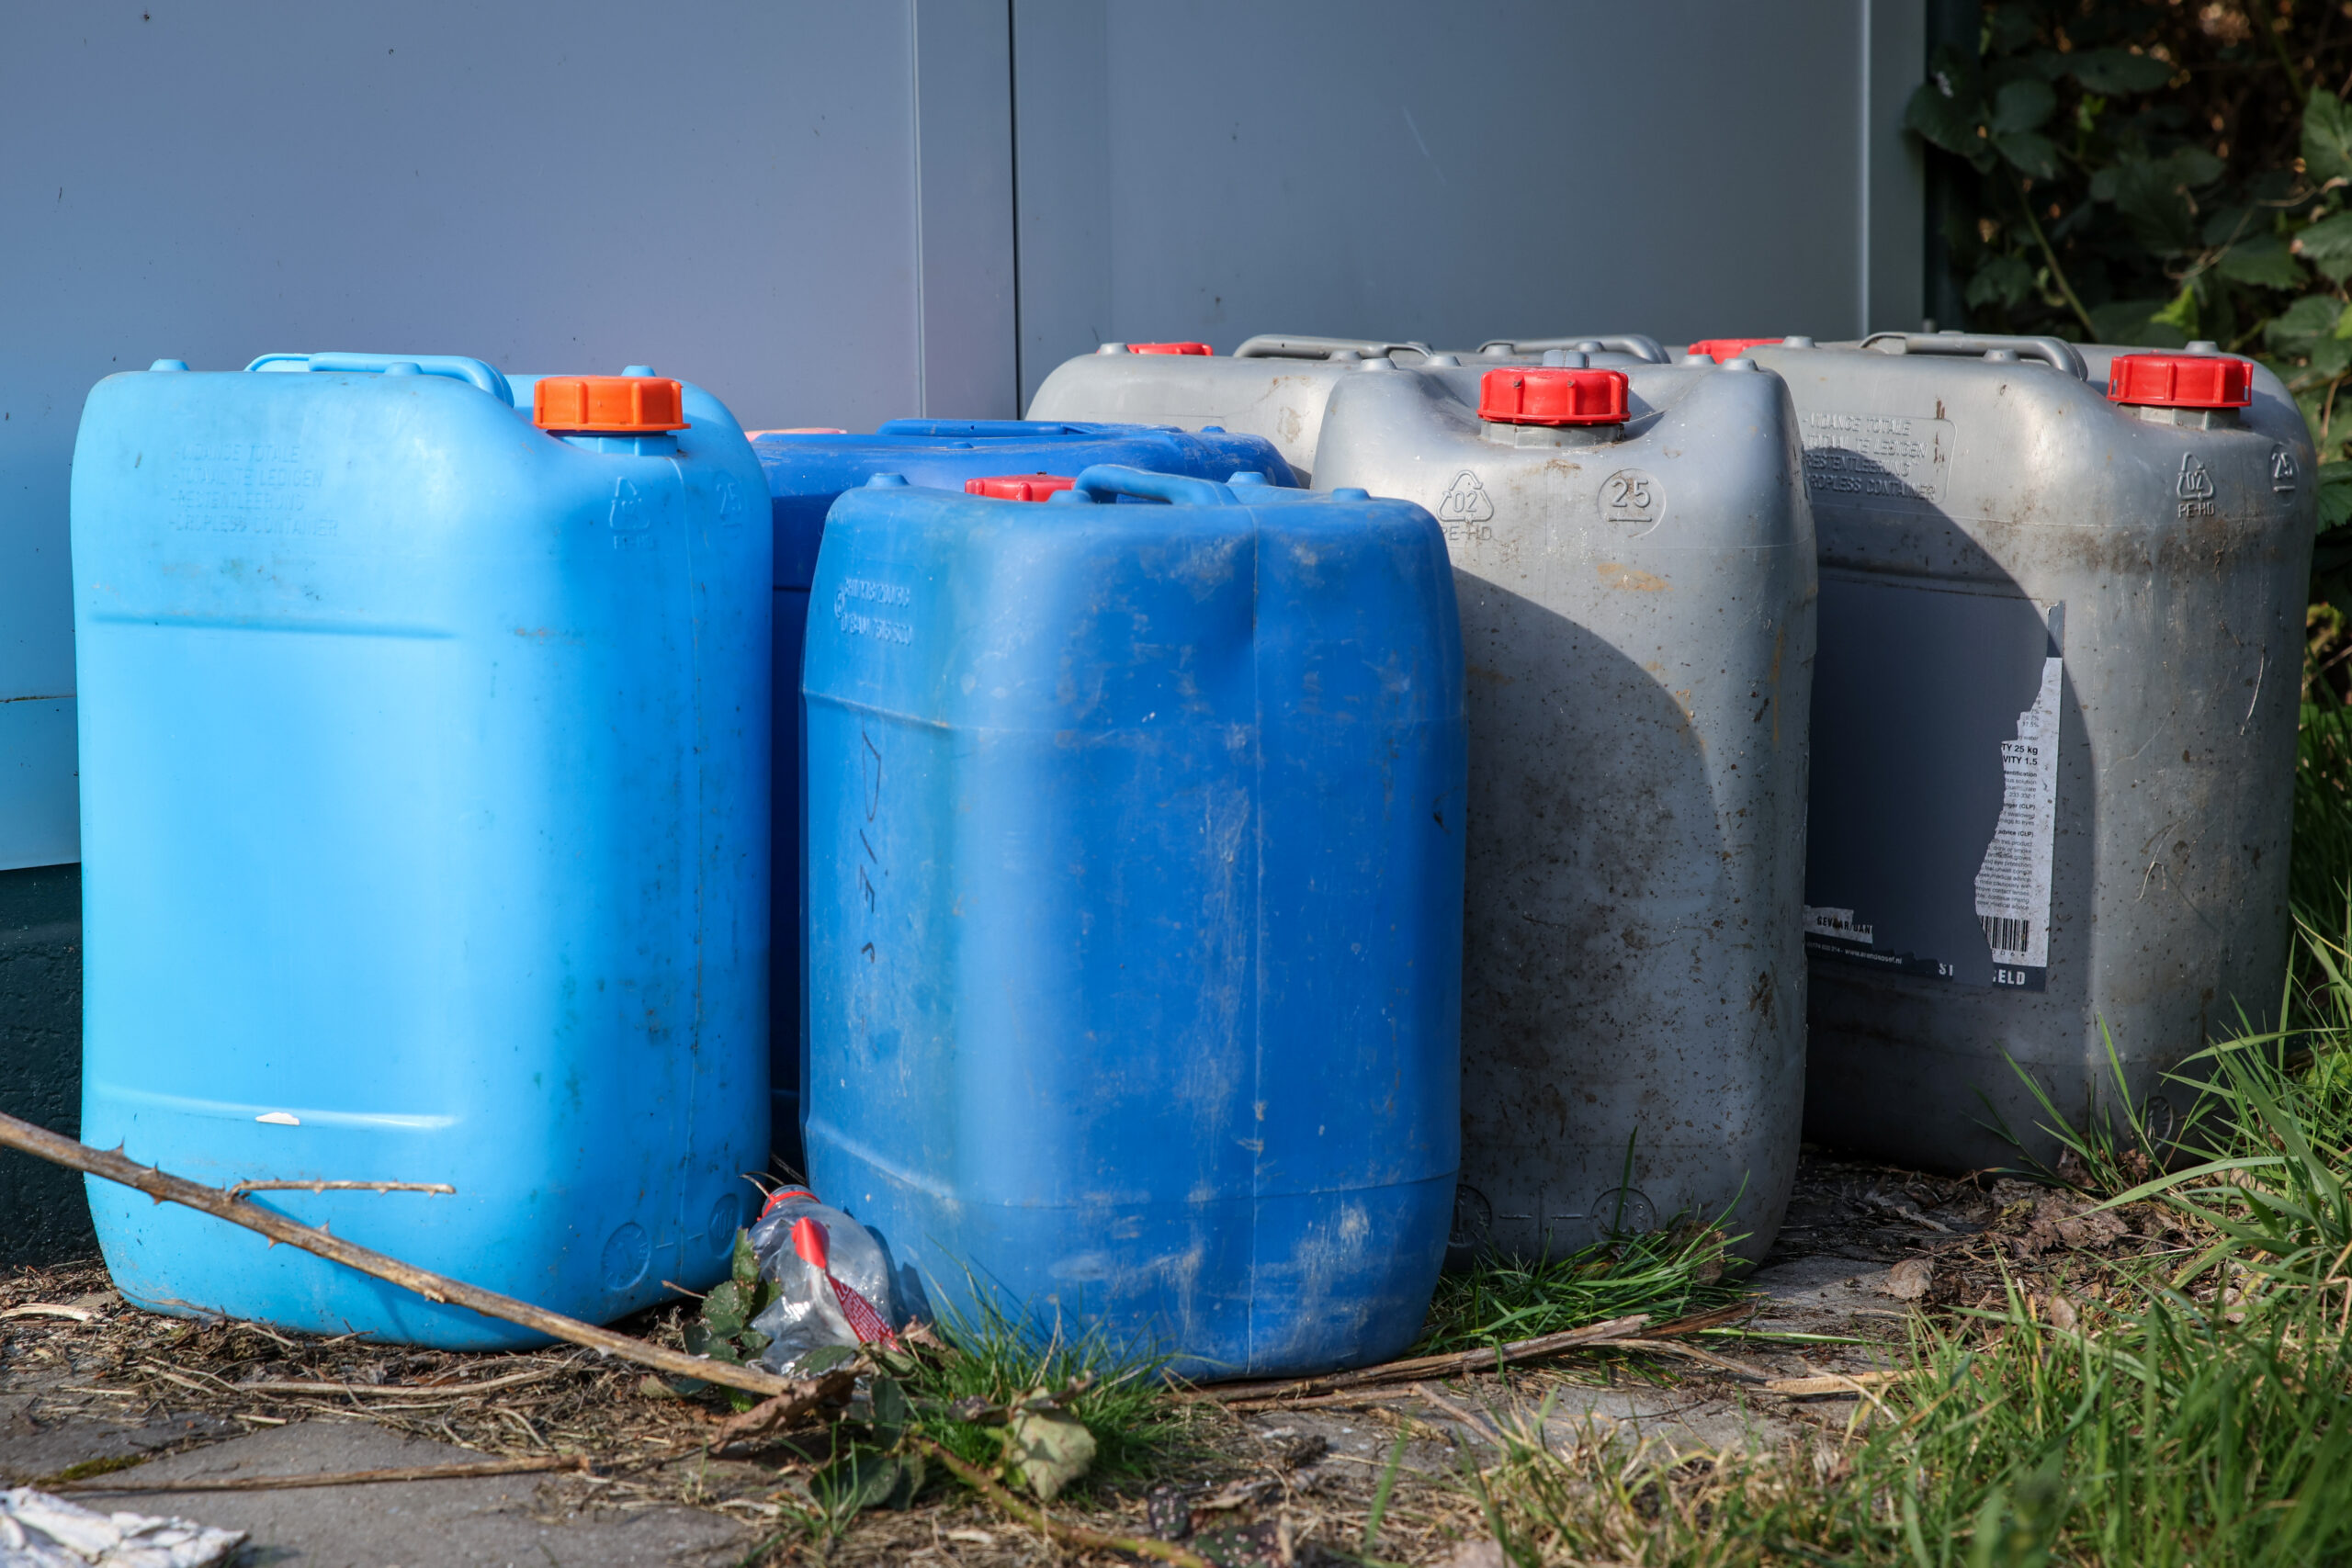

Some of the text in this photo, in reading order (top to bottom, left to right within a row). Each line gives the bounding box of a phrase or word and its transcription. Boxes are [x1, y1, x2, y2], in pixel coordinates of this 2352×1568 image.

[1867, 419, 1912, 436] TOTALE
[1856, 438, 1870, 454] TE
[1874, 440, 1928, 458] LEDIGEN
[2271, 452, 2293, 478] 25
[1807, 473, 1936, 500] ROPLESS CONTAINER
[2186, 471, 2204, 491] 02
[1453, 491, 1478, 513] 02
[1611, 478, 1651, 508] 25
[2177, 502, 2215, 518] PE-HD
[2003, 755, 2038, 766] VITY 1.5
[2014, 745, 2025, 753] 25
[2027, 746, 2039, 756] kg
